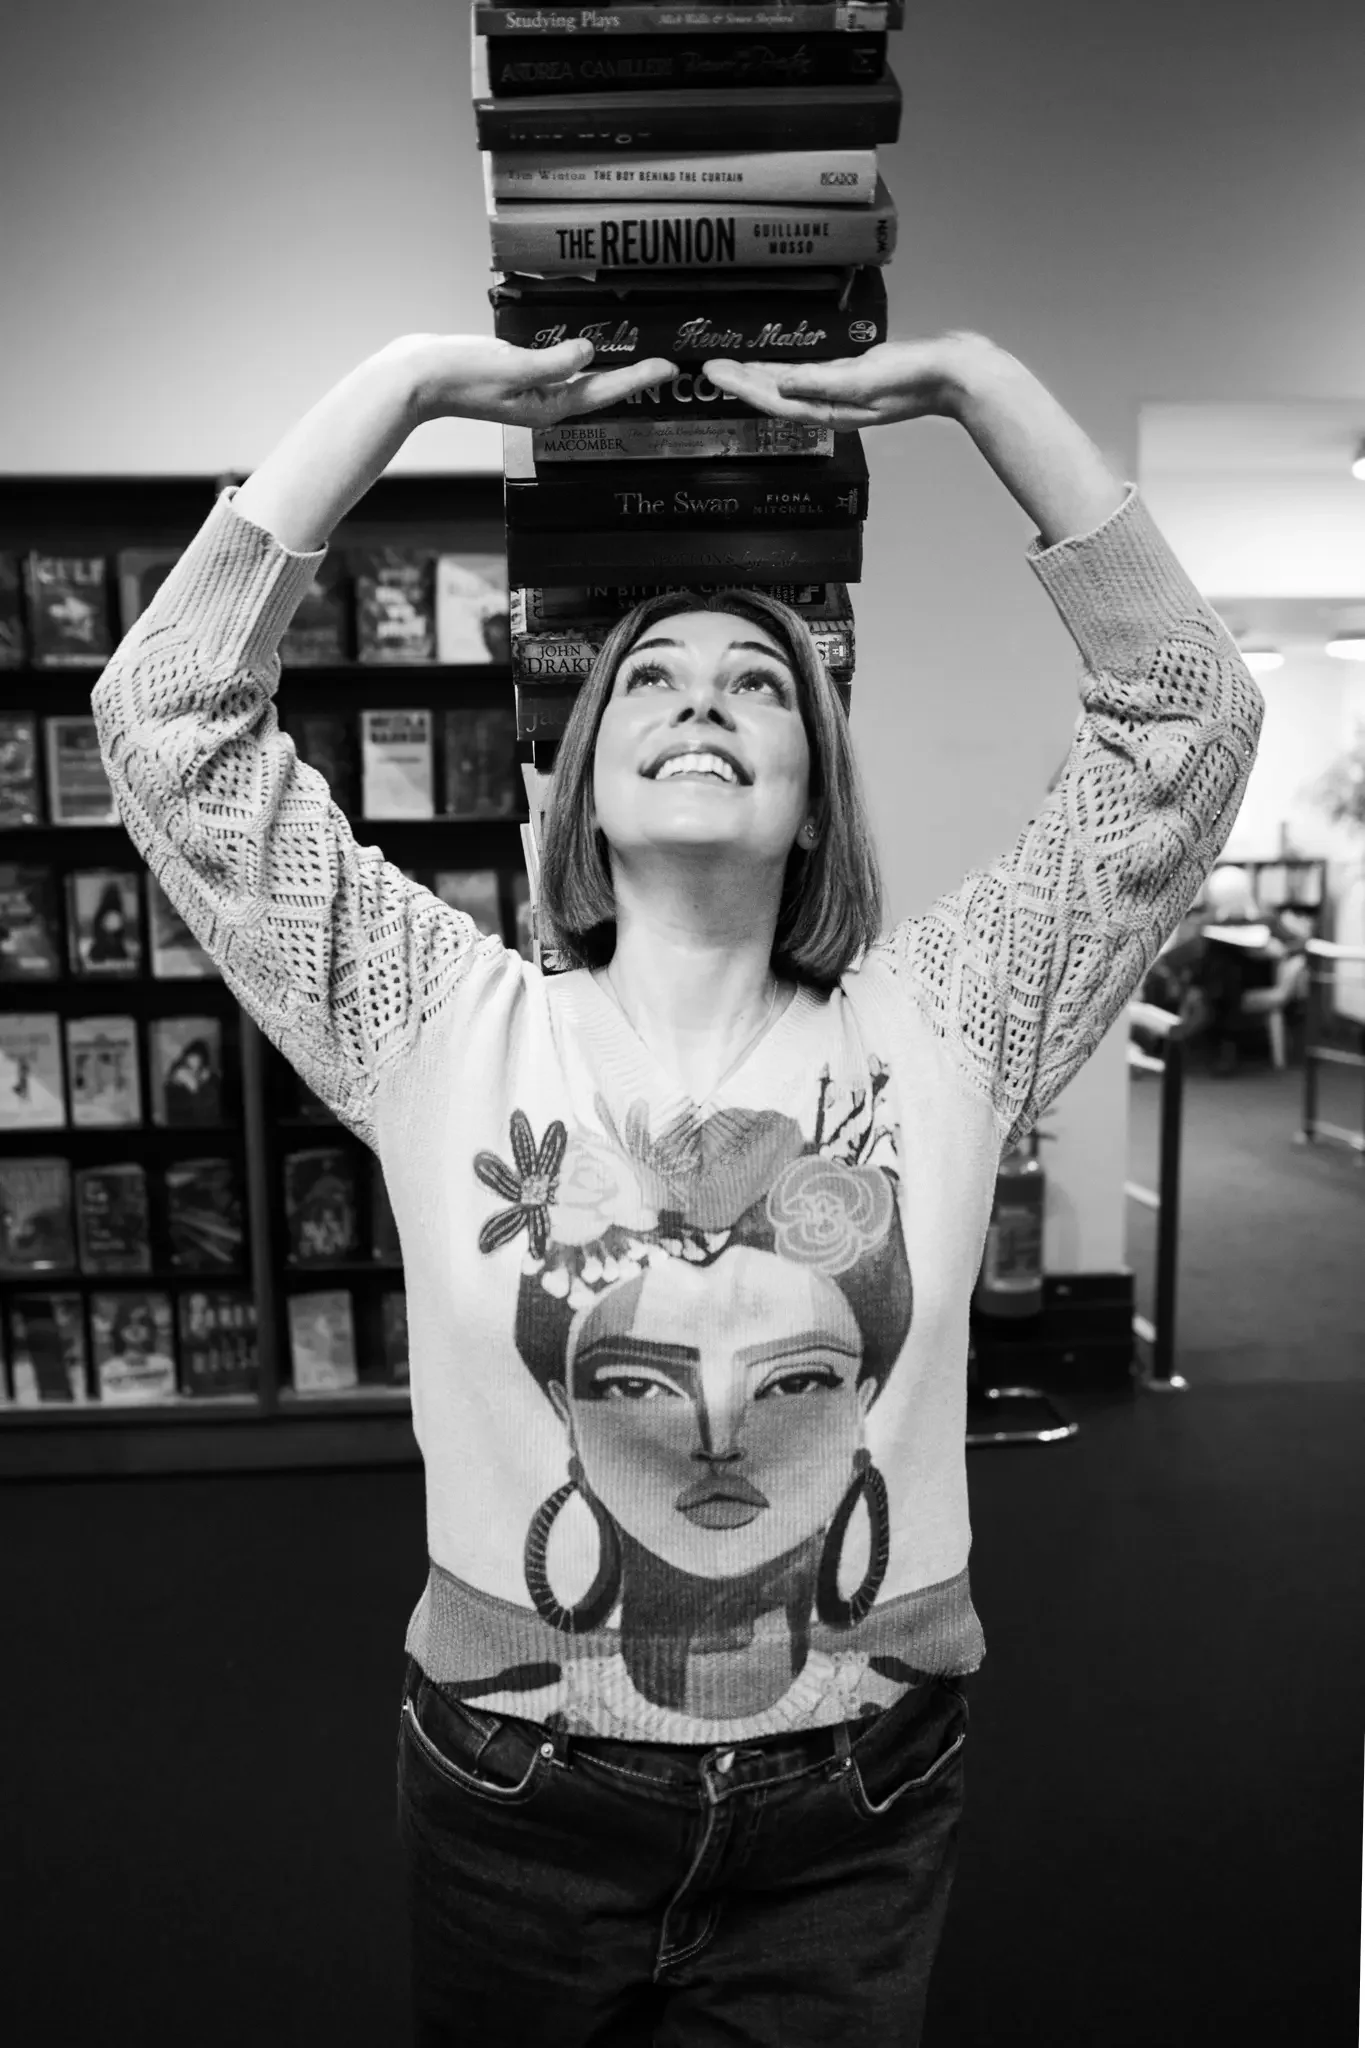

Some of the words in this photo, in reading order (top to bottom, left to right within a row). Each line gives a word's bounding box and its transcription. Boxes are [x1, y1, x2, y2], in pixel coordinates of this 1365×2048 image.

[506, 10, 578, 32] Studying
[580, 10, 621, 32] Plays
[594, 170, 613, 181] THE
[616, 170, 635, 181] BOY
[639, 171, 676, 182] BEHIND
[679, 171, 697, 182] THE
[701, 172, 743, 182] CURTAIN
[754, 223, 830, 238] GUILLAUME
[556, 228, 596, 260] THE
[600, 217, 735, 266] REUNION
[672, 317, 743, 351] Kevin
[745, 319, 827, 348] Maher
[560, 429, 607, 440] DEBBIE
[544, 438, 629, 452] MACOMBER
[614, 492, 665, 515] The
[673, 491, 740, 519] Swap
[766, 493, 812, 504] FIONA
[753, 505, 825, 515] MITCHELL
[540, 645, 581, 660] JOHN
